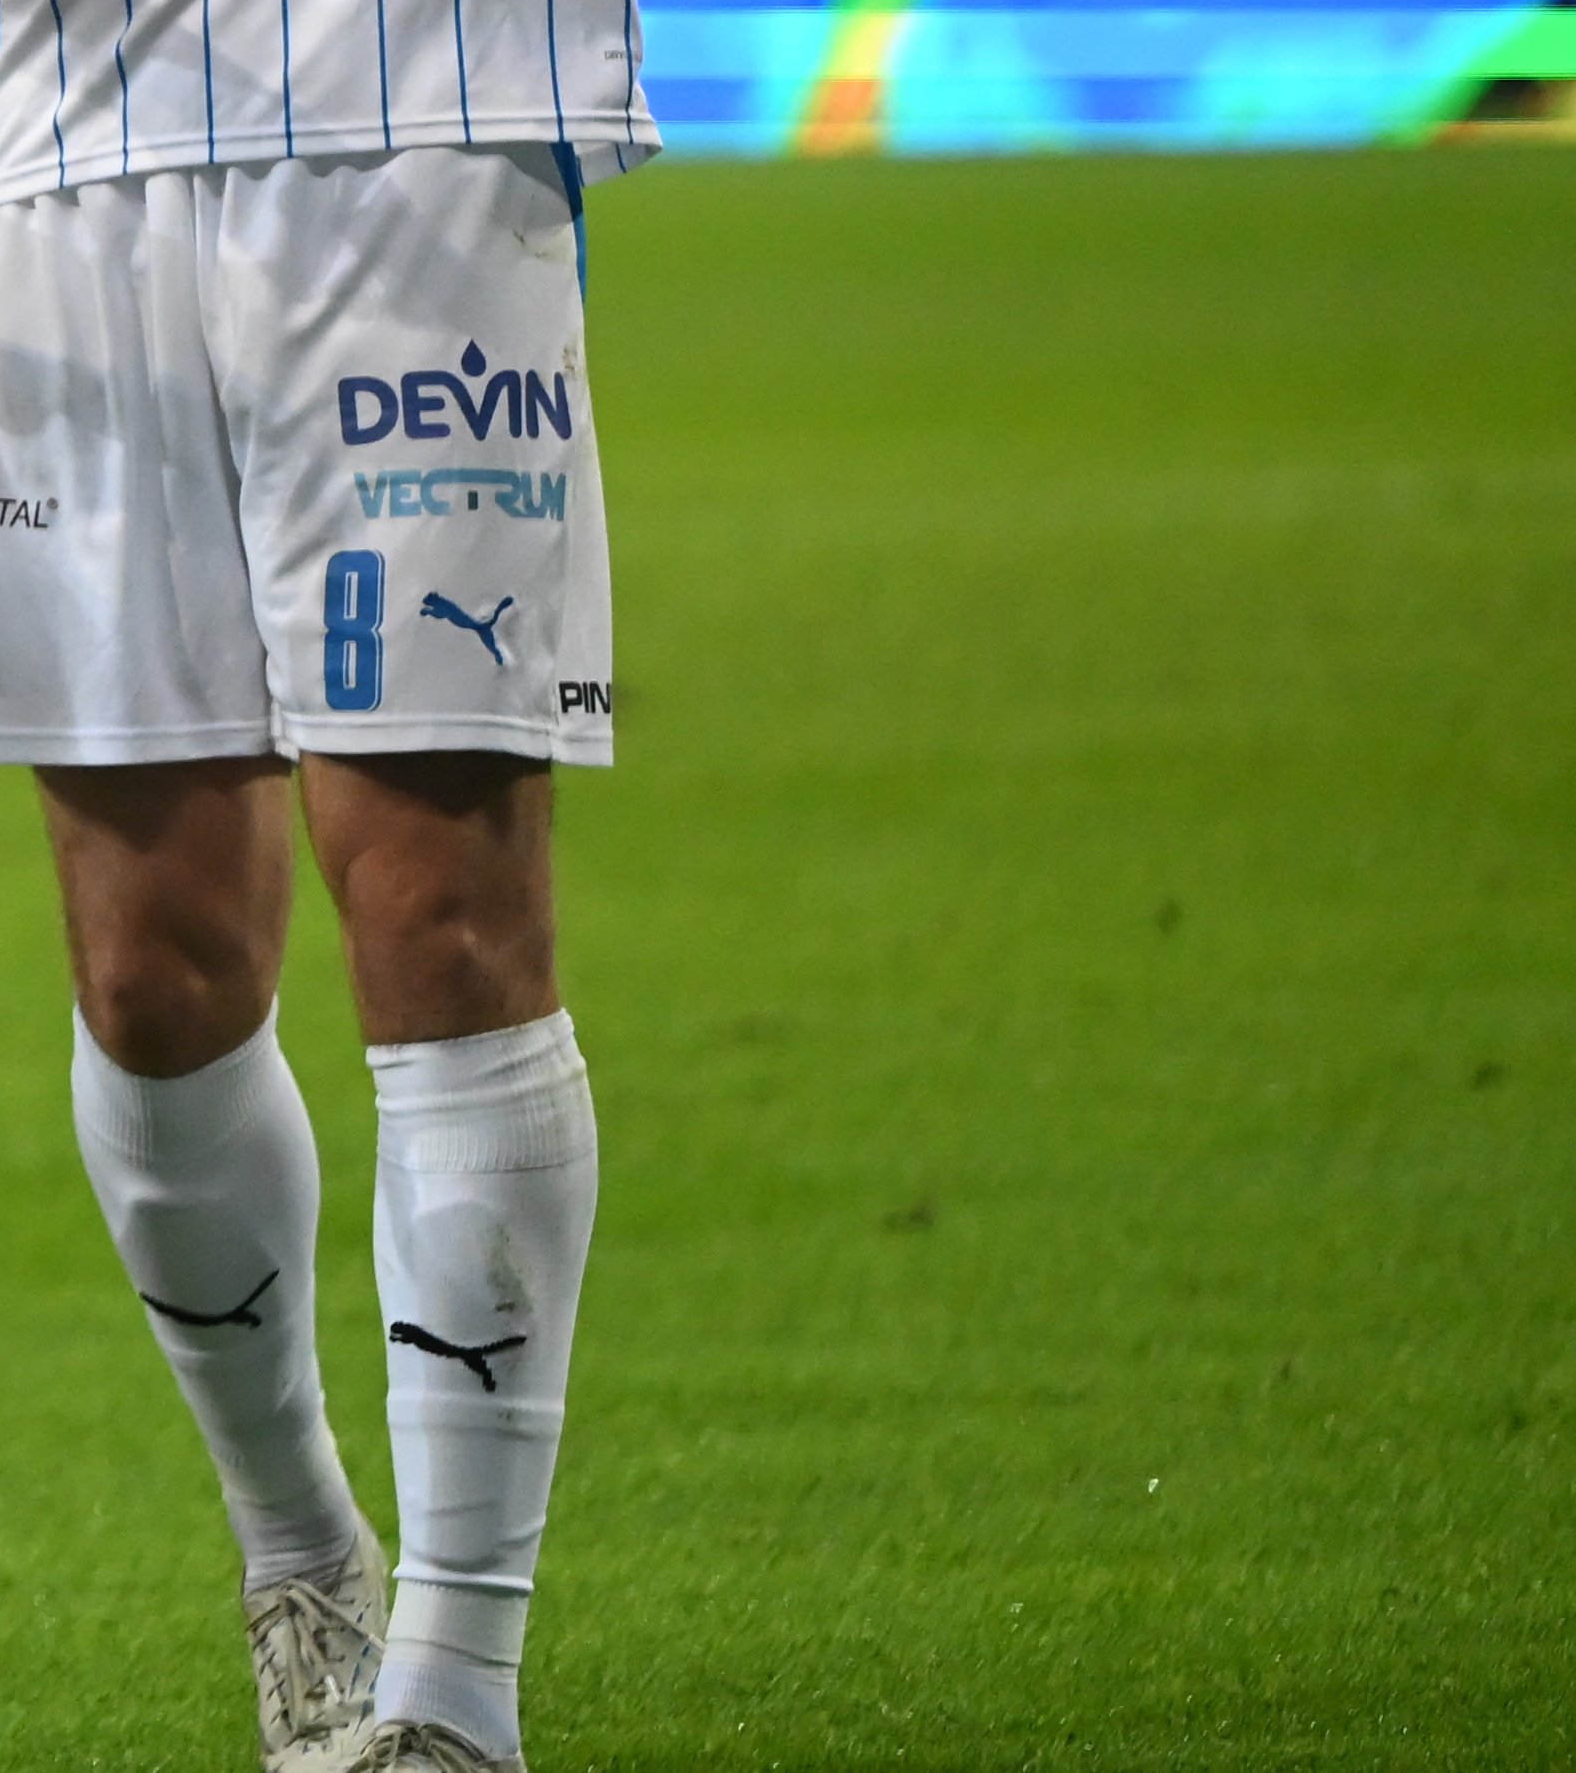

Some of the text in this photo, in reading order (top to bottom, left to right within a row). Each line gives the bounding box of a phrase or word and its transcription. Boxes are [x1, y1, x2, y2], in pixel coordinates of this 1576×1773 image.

[338, 366, 572, 446] DEVIN
[353, 468, 567, 524] VECTRUM
[324, 549, 386, 713] 8
